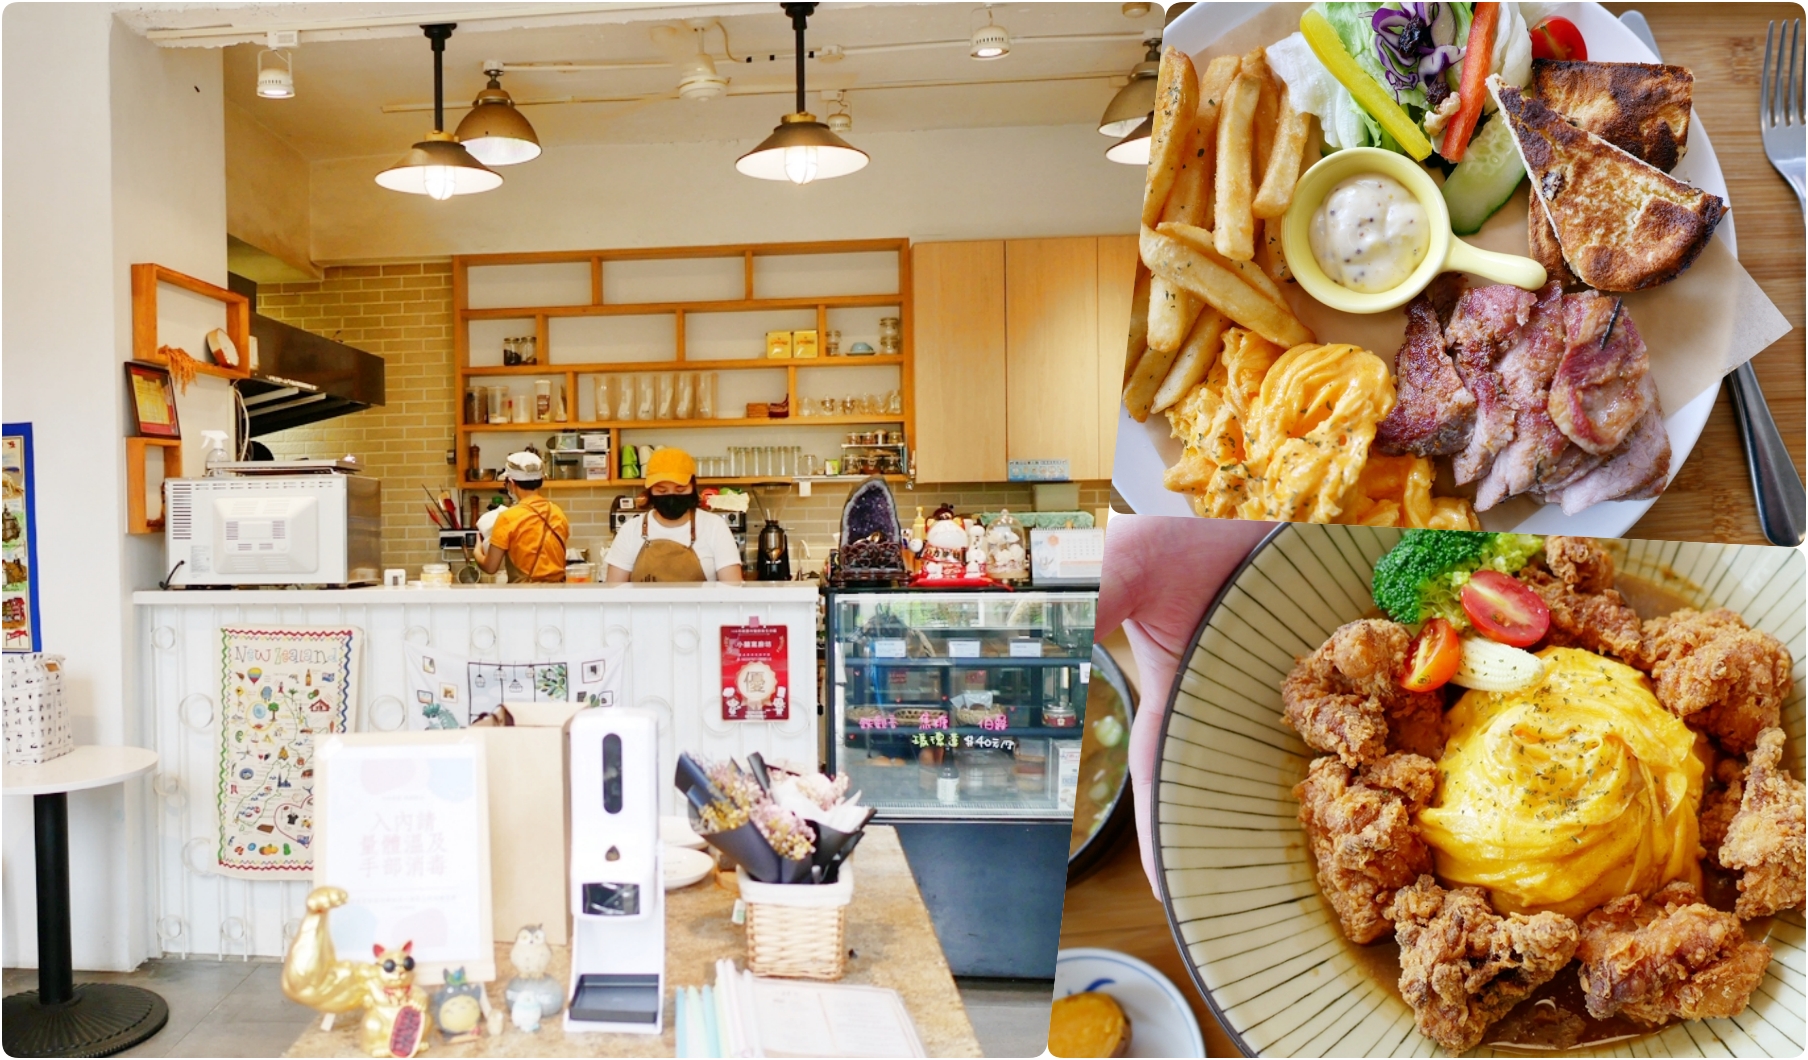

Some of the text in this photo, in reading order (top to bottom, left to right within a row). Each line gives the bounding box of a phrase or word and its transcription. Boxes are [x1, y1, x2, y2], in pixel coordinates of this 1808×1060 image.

[274, 647, 337, 665] Zealand
[744, 672, 765, 693] 優
[371, 811, 436, 833] 入內請
[360, 833, 447, 857] 量體溫及
[359, 855, 448, 878] 手部消毒
